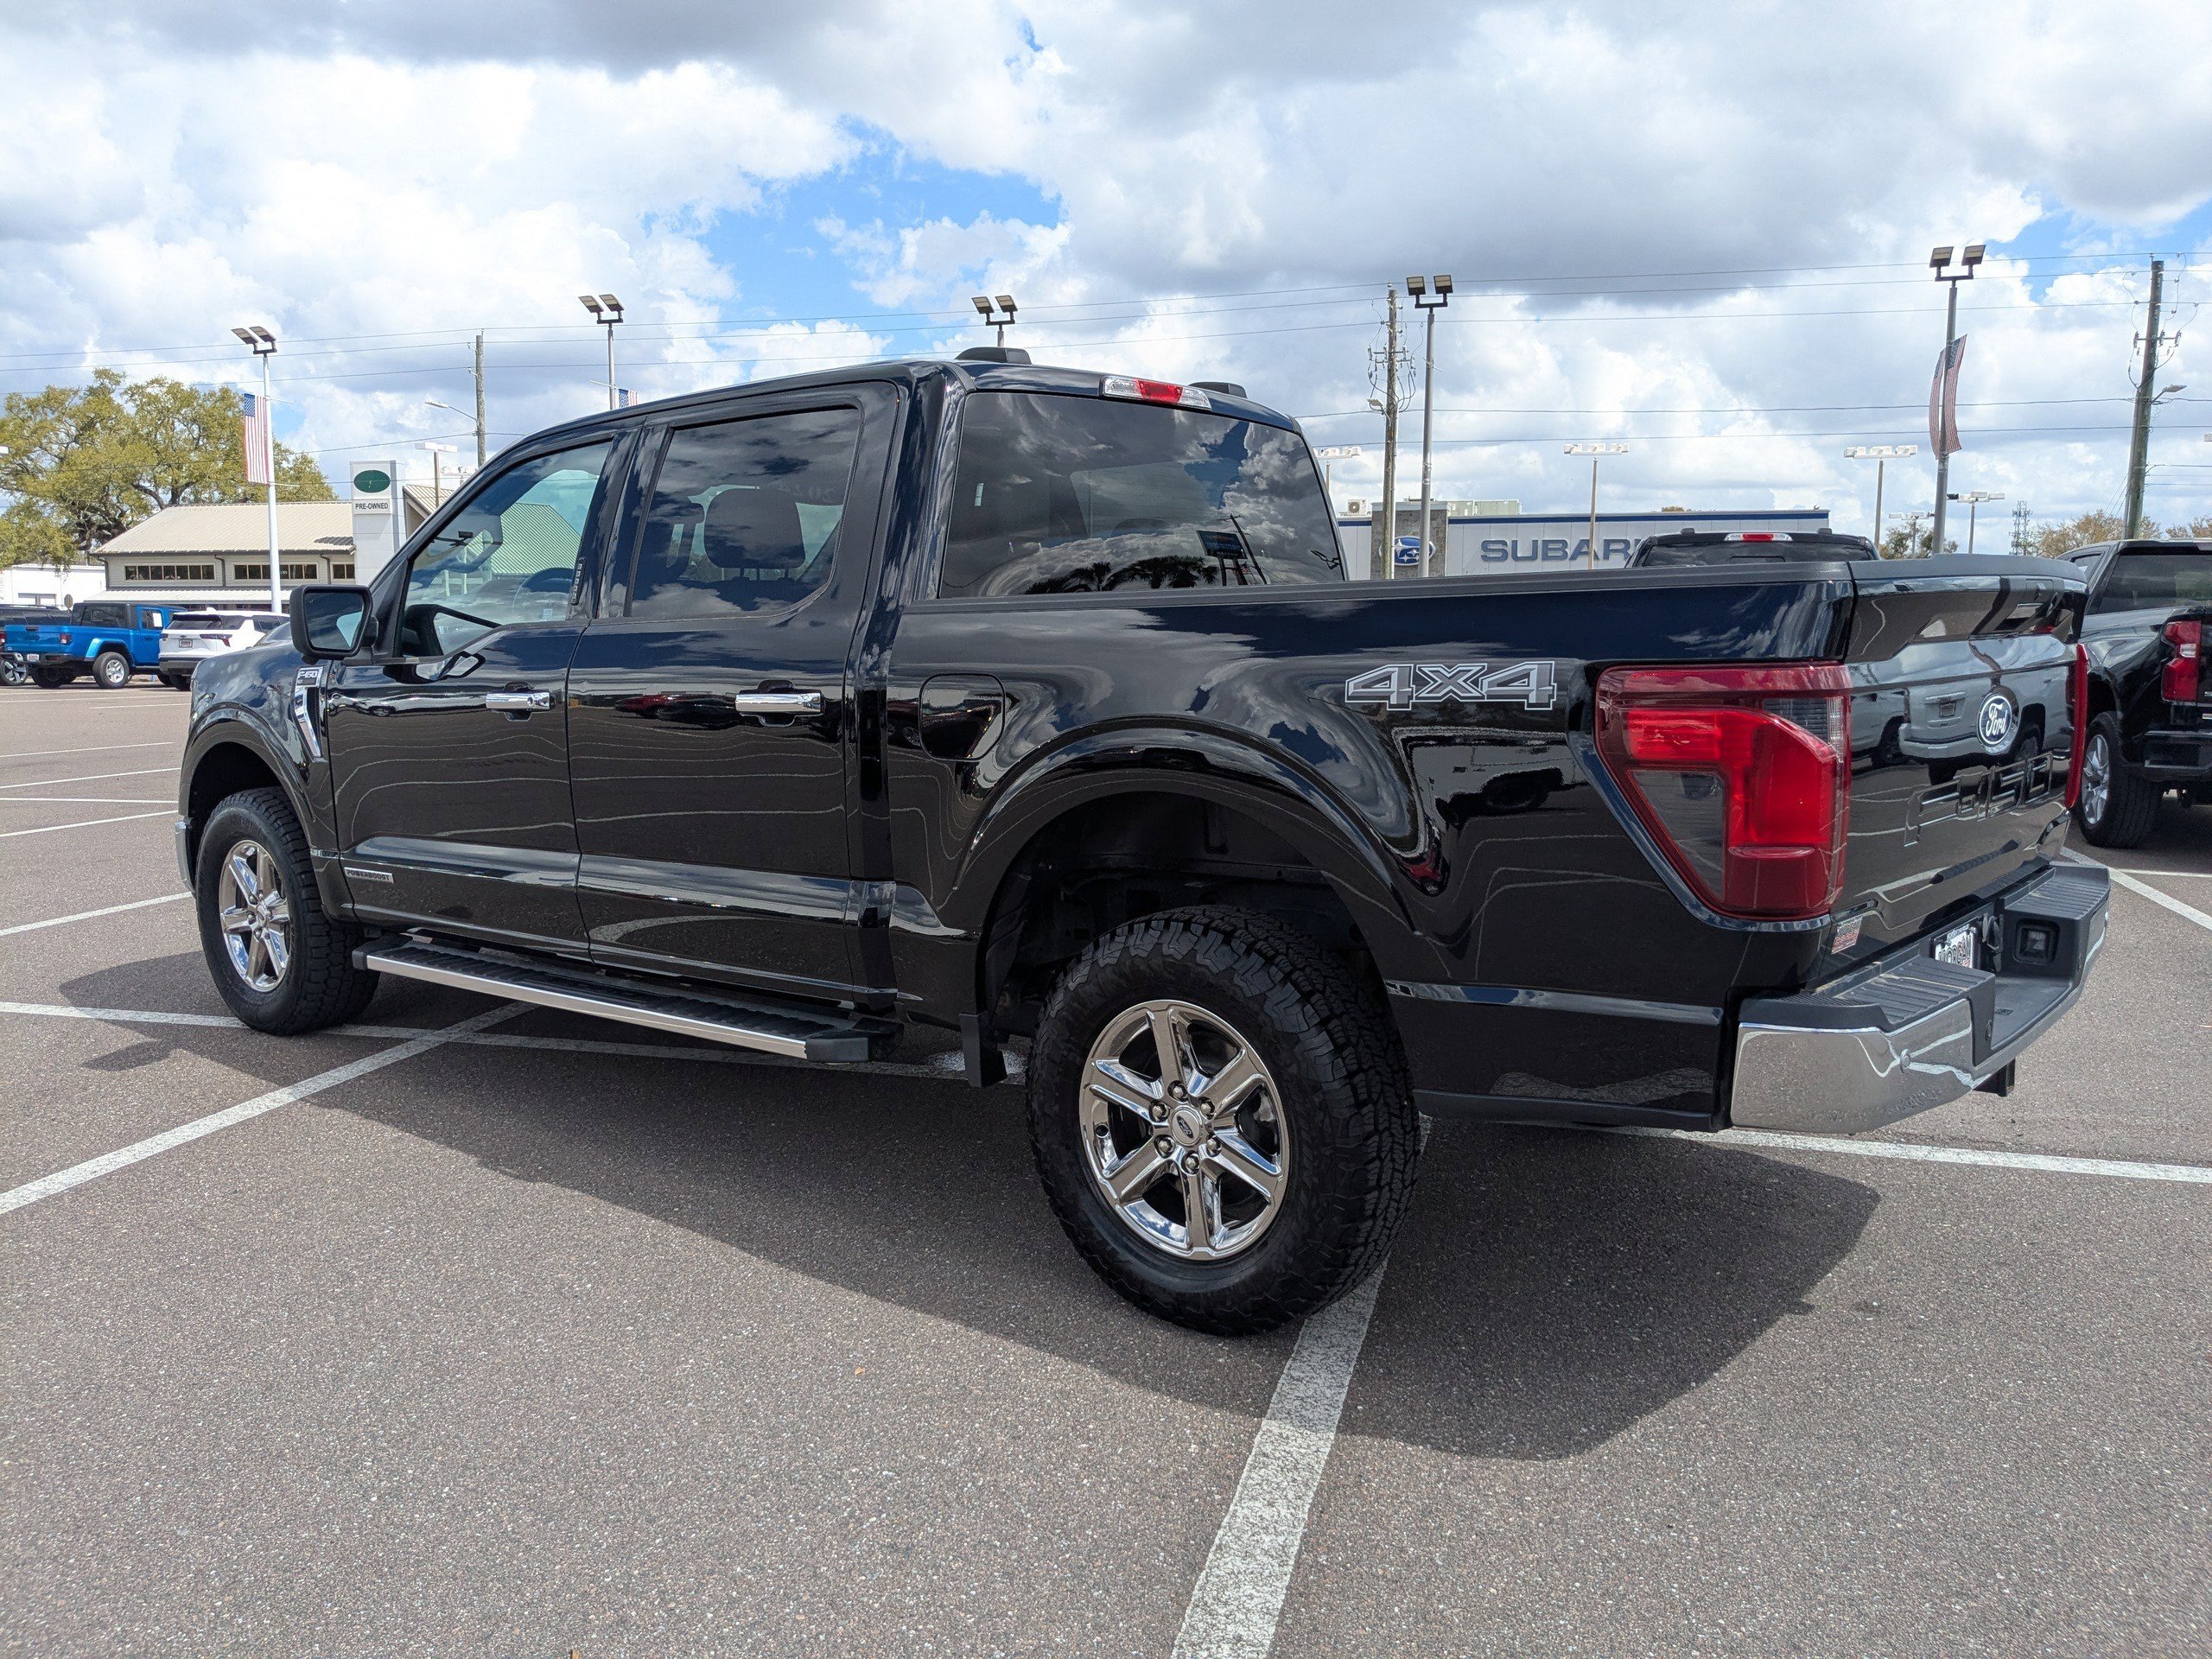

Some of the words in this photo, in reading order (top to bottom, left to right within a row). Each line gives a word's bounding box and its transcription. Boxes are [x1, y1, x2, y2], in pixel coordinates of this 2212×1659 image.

[1480, 539, 1641, 563] SUBAR
[1984, 702, 2010, 739] Ford
[346, 868, 391, 881] POWERBOOST
